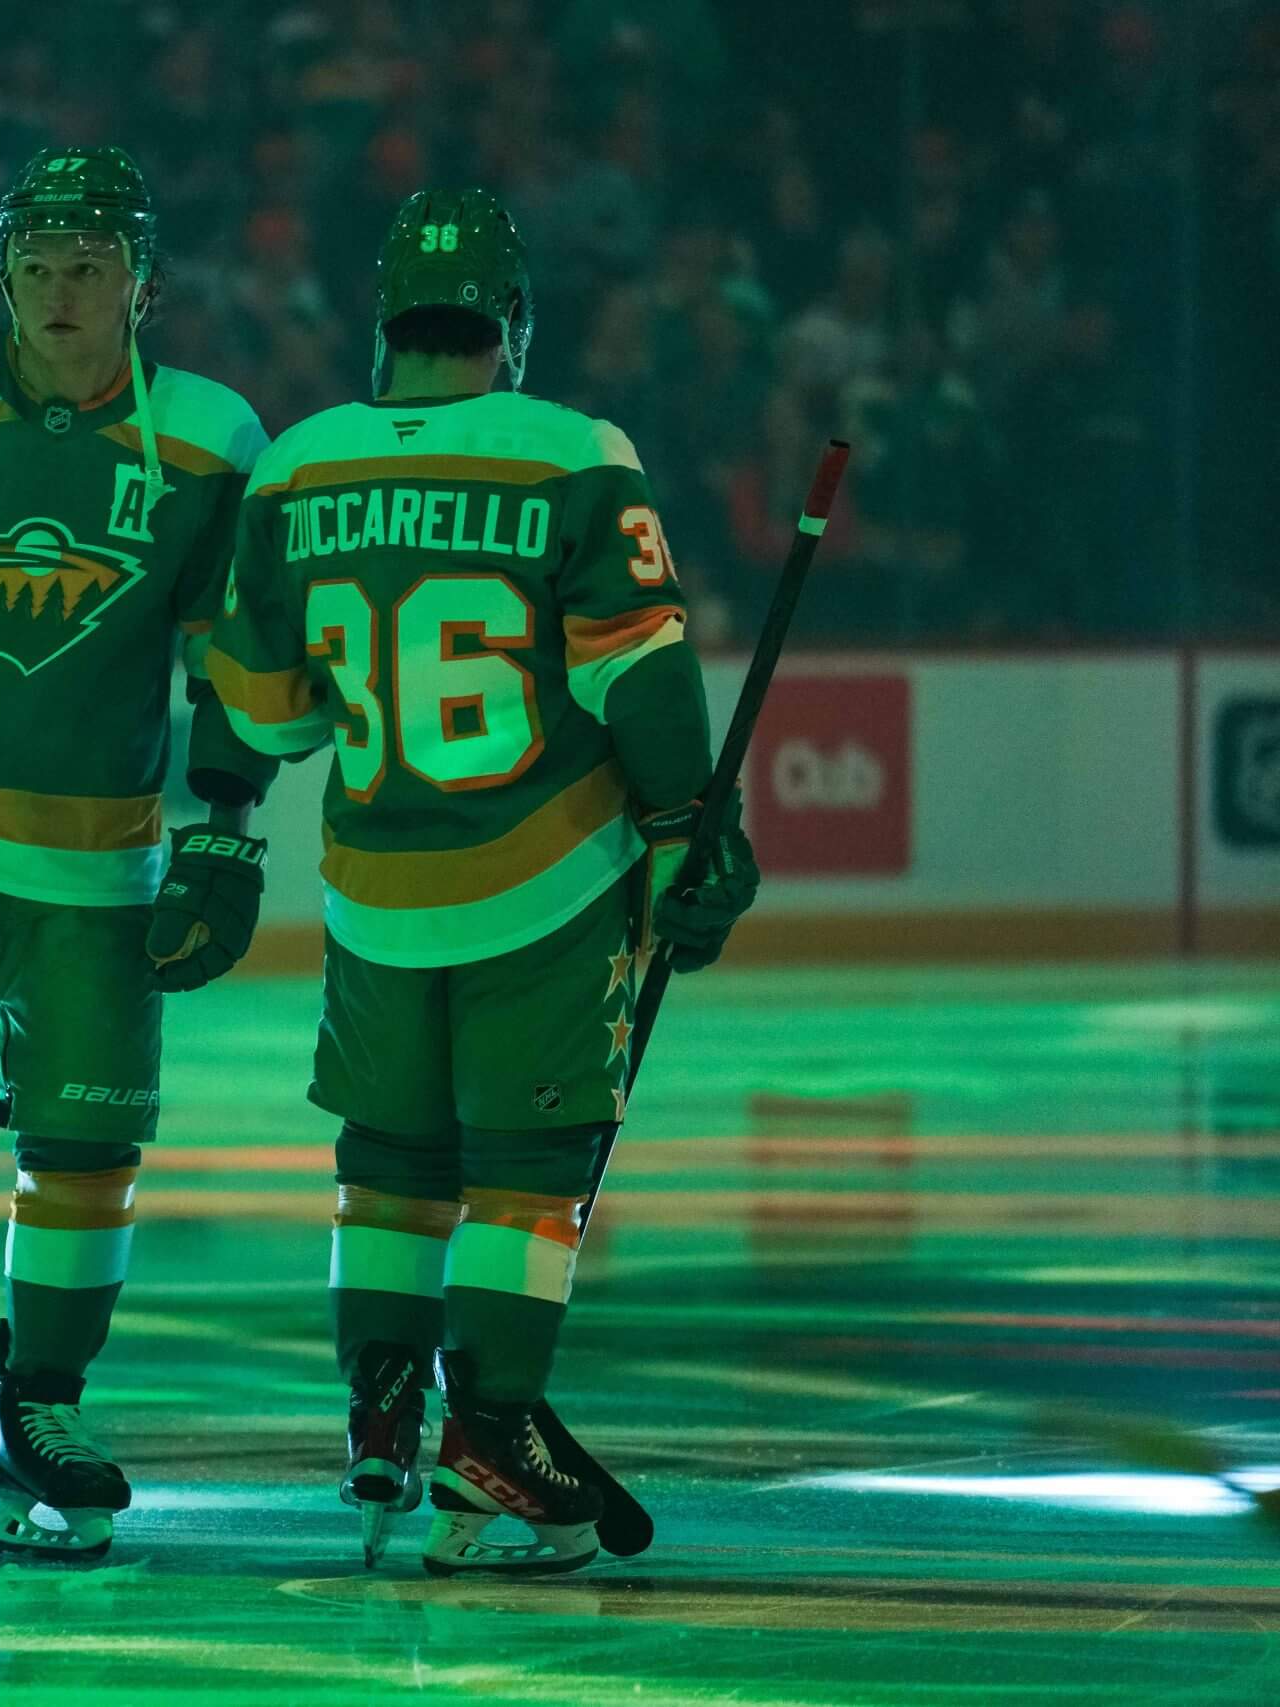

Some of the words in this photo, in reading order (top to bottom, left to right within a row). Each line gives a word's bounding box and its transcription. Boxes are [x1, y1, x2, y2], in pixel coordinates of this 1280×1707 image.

[47, 158, 89, 172] 97
[420, 223, 460, 253] 36
[114, 478, 147, 532] A
[281, 488, 551, 562] ZUCCARELLO
[305, 573, 545, 804] 36
